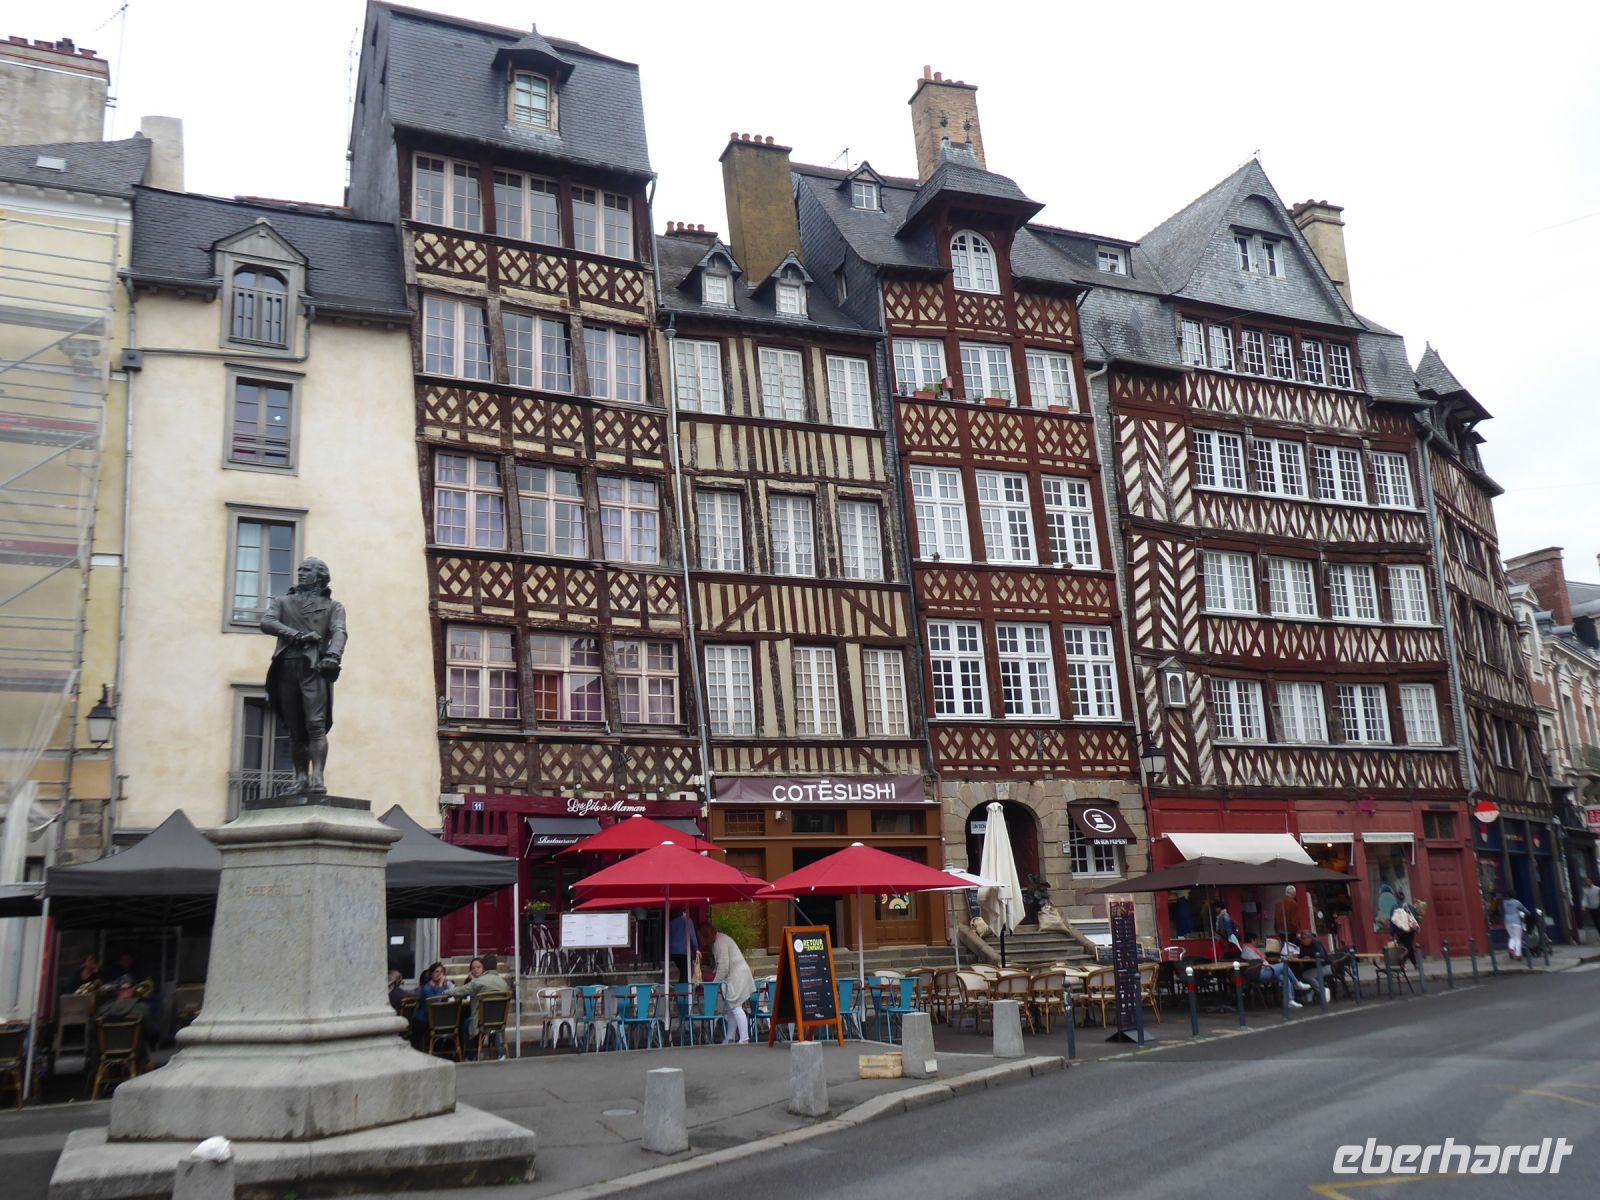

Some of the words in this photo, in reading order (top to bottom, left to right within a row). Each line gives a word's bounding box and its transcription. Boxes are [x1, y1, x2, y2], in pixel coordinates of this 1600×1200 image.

[474, 802, 482, 810] 11
[608, 800, 647, 812] Maman
[537, 836, 579, 844] Restaurant
